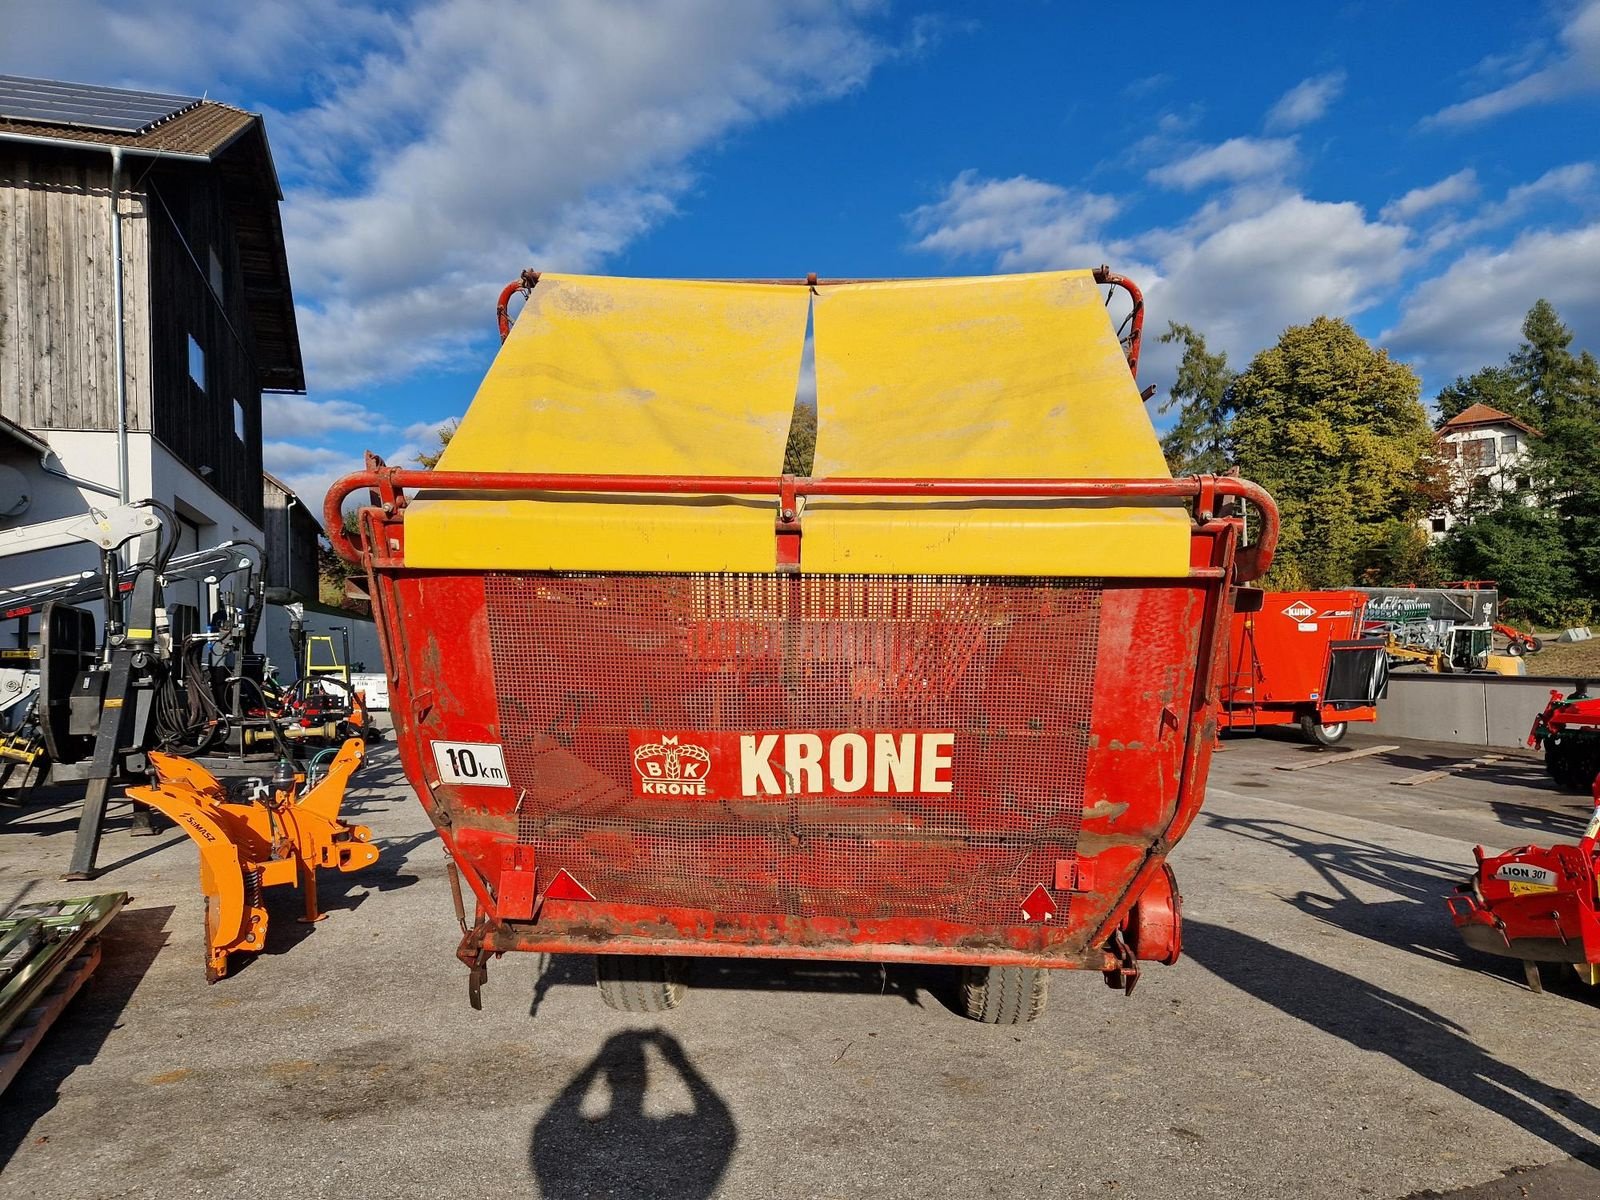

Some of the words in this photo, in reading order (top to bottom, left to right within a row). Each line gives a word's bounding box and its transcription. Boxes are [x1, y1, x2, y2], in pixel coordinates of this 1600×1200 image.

[1288, 608, 1312, 616] KUHN
[661, 734, 679, 746] M
[645, 761, 663, 777] B
[683, 763, 700, 778] K
[740, 732, 955, 797] KRONE
[642, 782, 707, 796] KRONE
[1502, 866, 1530, 878] LION
[1531, 869, 1547, 880] 301
